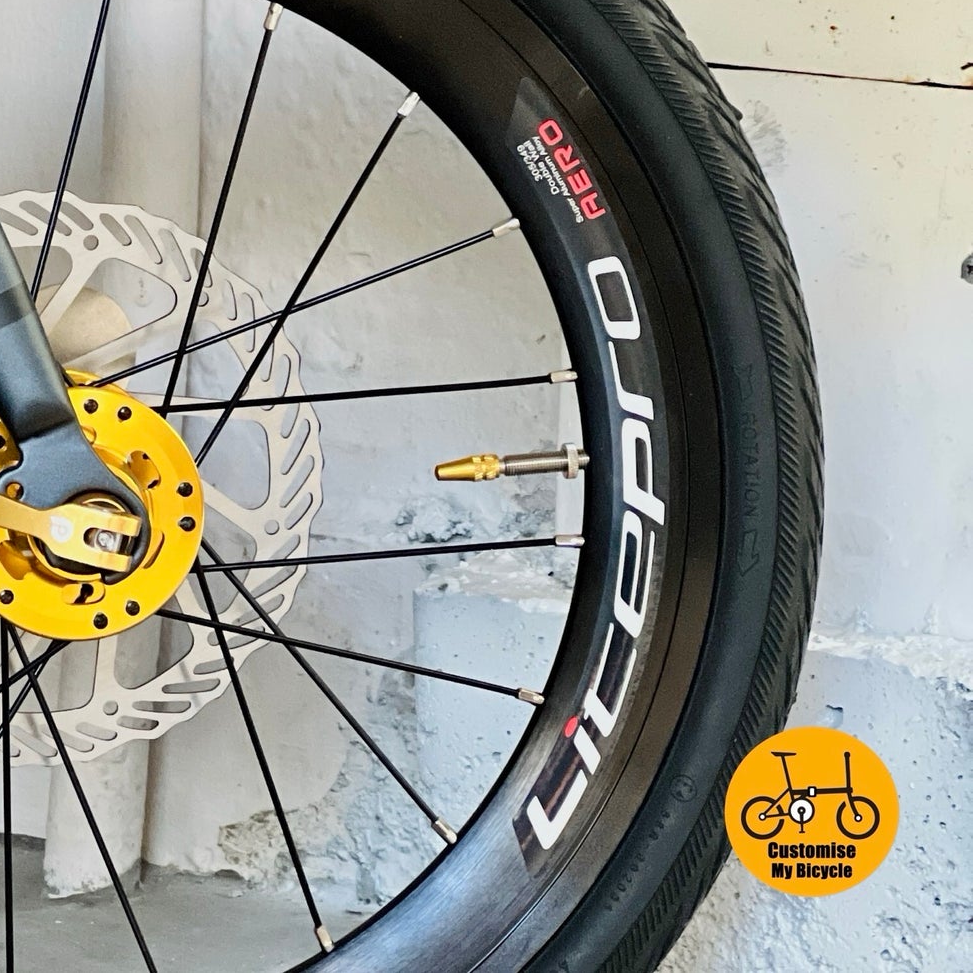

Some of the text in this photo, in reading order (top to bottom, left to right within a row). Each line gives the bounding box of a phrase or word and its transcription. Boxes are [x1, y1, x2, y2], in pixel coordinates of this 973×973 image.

[517, 143, 543, 181] 305/349
[523, 139, 560, 195] Double Wall
[532, 135, 585, 223] Super Aluminum Alloy
[539, 119, 606, 221] AERO
[527, 256, 666, 851] Litepro
